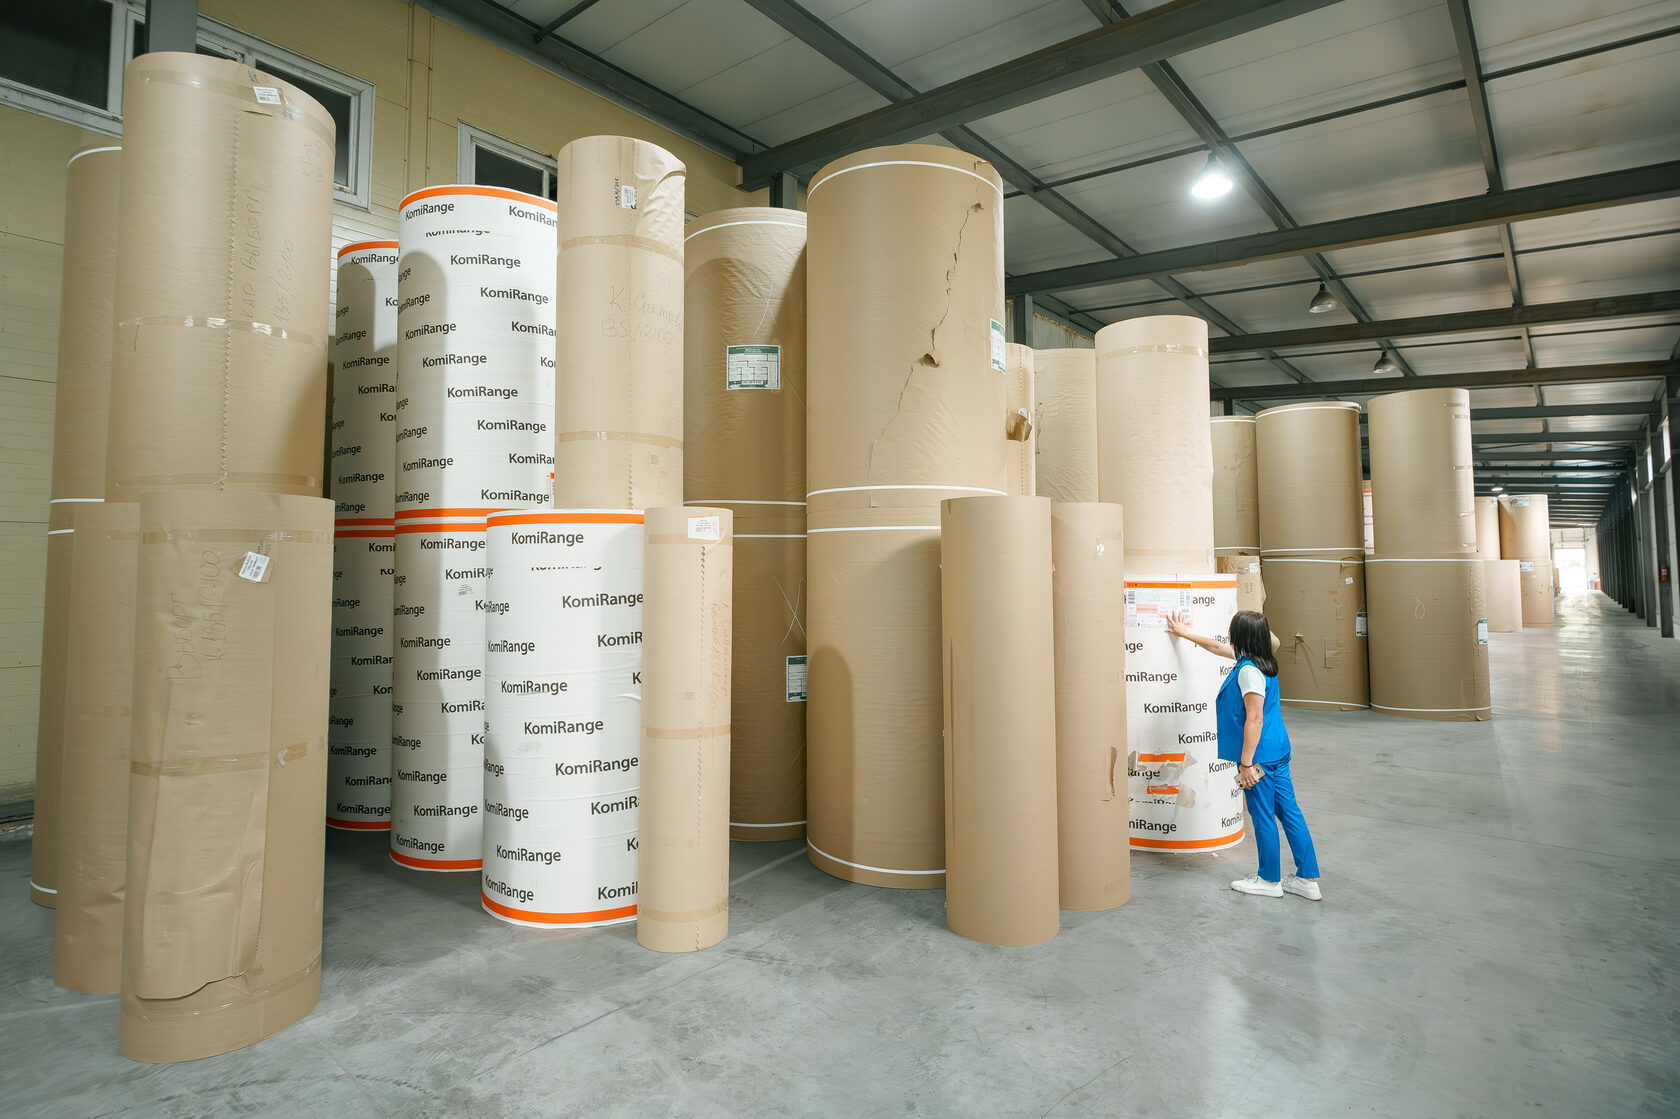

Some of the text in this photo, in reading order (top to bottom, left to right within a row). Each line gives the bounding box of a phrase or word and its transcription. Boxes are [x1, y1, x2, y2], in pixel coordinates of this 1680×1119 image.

[405, 203, 455, 221] KomiRange
[450, 254, 521, 269] KomiRange
[480, 287, 549, 305] KomiRange
[405, 322, 457, 341] KomiRange
[342, 357, 390, 370] KomiRange
[422, 353, 487, 368] KomiRange
[447, 386, 519, 400] KomiRange
[477, 420, 547, 434] KomiRange
[402, 457, 454, 472] KomiRange
[338, 473, 385, 485] KomiRange
[481, 490, 550, 504] KomiRange
[420, 538, 487, 551] KomiRange
[511, 531, 584, 547] KomiRange
[562, 593, 643, 608] KomiRange
[335, 627, 384, 638] KomiRange
[400, 637, 451, 650] KomiRange
[488, 640, 535, 655] KomiRange
[416, 669, 482, 681] KomiRange
[501, 680, 568, 696] KomiRange
[1143, 702, 1208, 714] KomiRange
[524, 720, 604, 735] KomiRange
[1178, 731, 1219, 745] KomiRa
[330, 745, 377, 758] KomiRange
[555, 757, 639, 776] KomiRange
[397, 769, 447, 785] KomiRange
[336, 802, 392, 817] KomiRange
[413, 805, 478, 818] KomiRange
[484, 799, 529, 822] KomiRange
[396, 833, 446, 855] KomiRange
[497, 844, 561, 865] KomiRange
[485, 875, 534, 903] KomiRange
